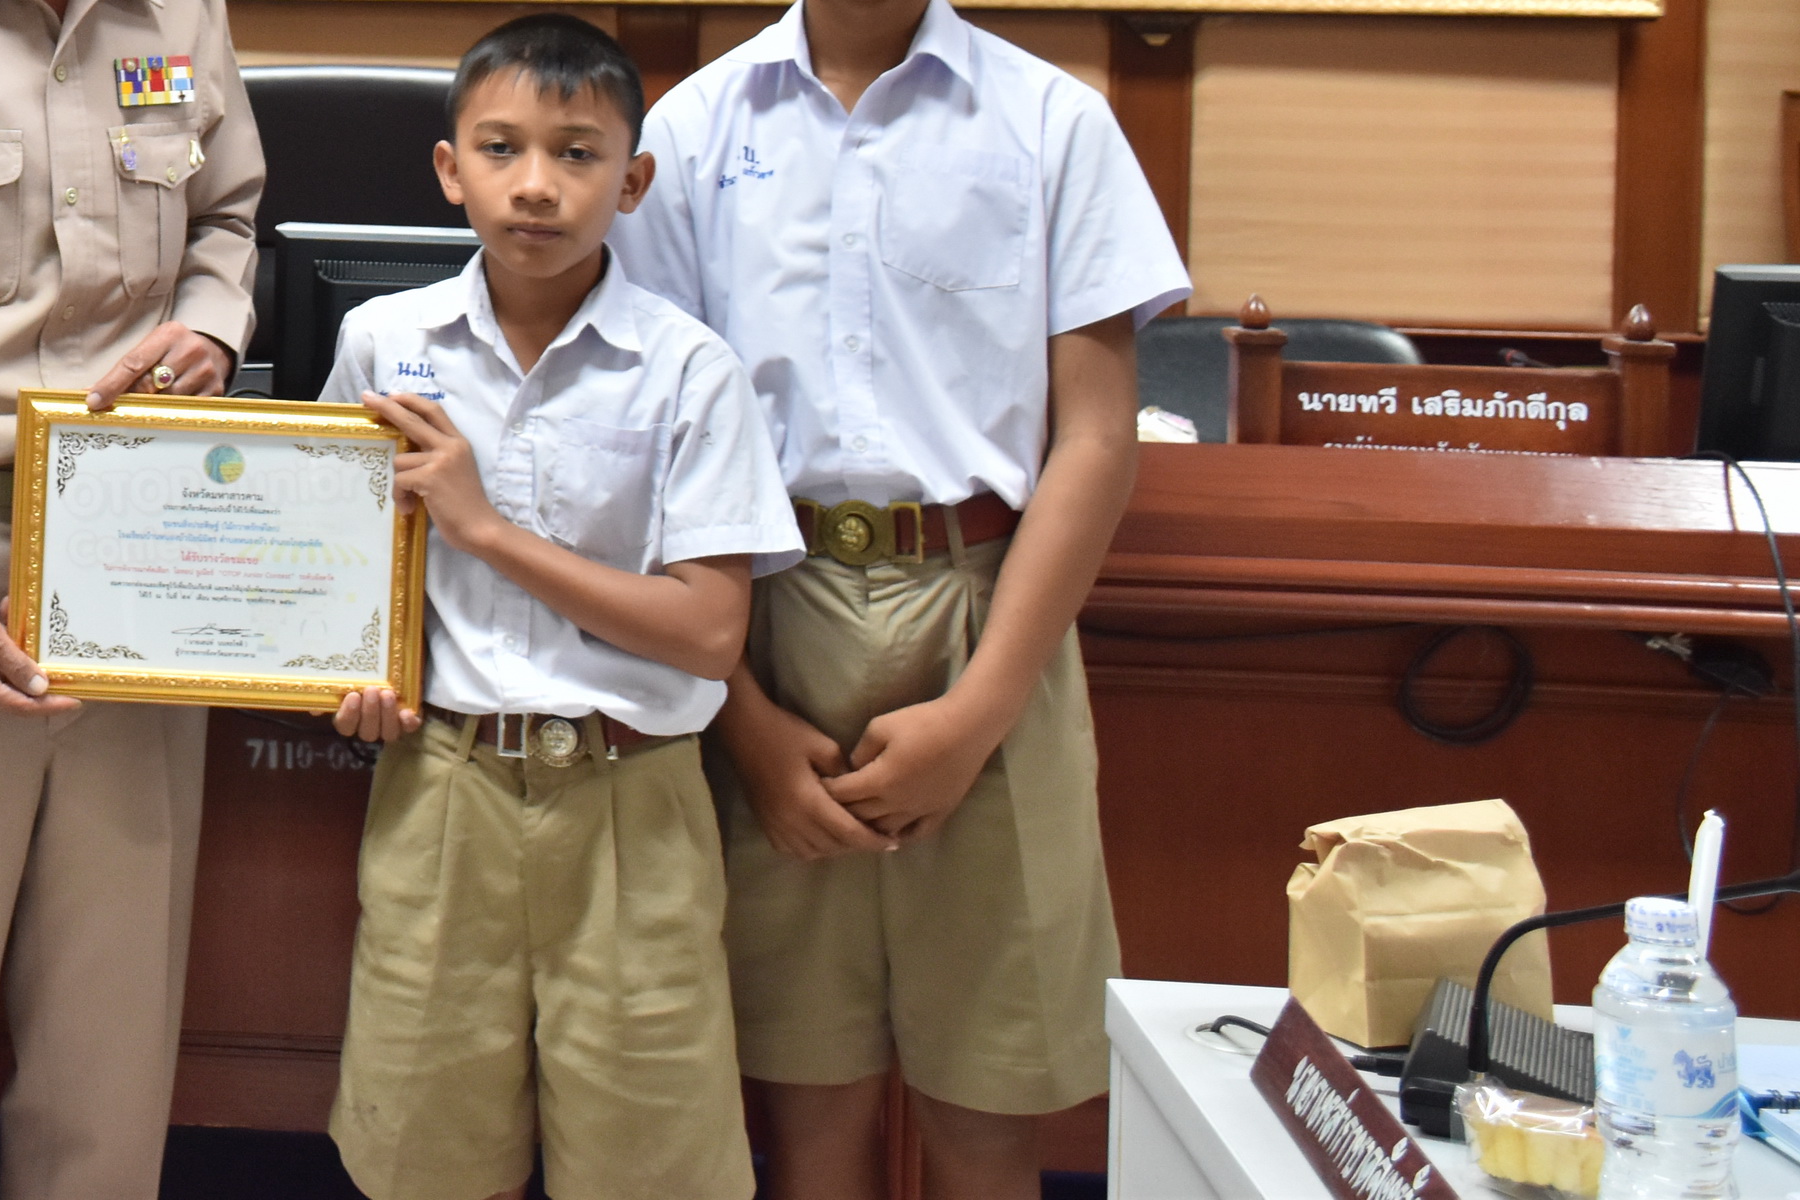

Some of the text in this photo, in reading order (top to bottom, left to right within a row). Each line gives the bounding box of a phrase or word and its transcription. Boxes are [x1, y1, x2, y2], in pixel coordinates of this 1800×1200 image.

[1298, 386, 1590, 431] นายทวี เสริมภักดีกุล
